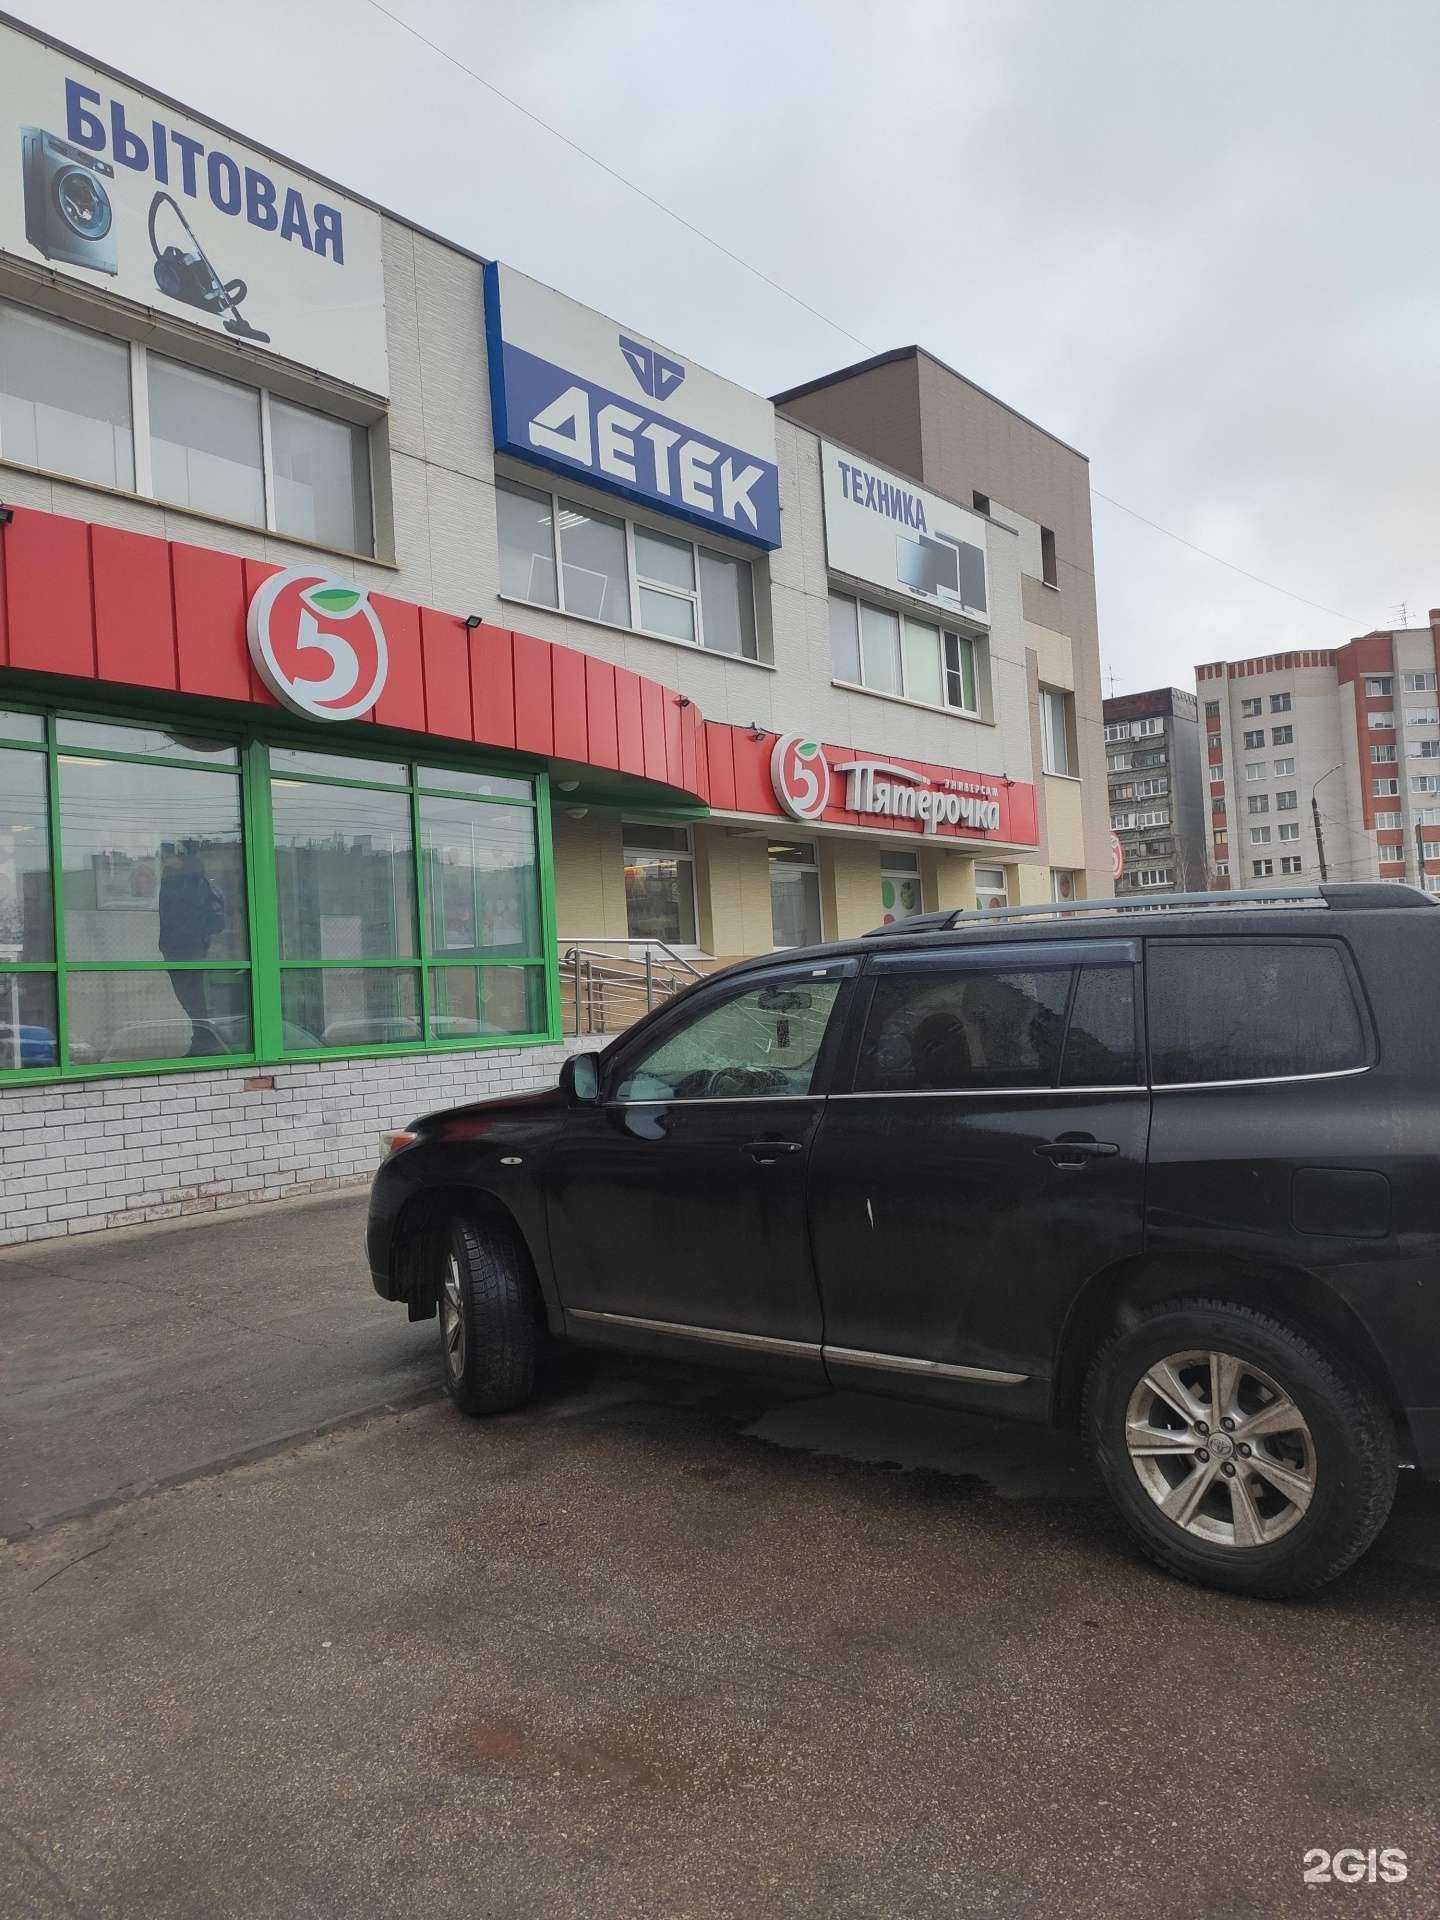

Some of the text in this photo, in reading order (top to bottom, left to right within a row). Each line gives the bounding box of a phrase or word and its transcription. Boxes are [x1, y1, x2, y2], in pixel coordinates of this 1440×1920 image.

[65, 78, 344, 265] БЫТОВАЯ
[529, 386, 764, 530] ДЕТЕК
[838, 461, 927, 533] ТЕХНИКА
[291, 608, 359, 701] 5
[791, 759, 818, 809] 5
[834, 761, 999, 833] Пятерочка
